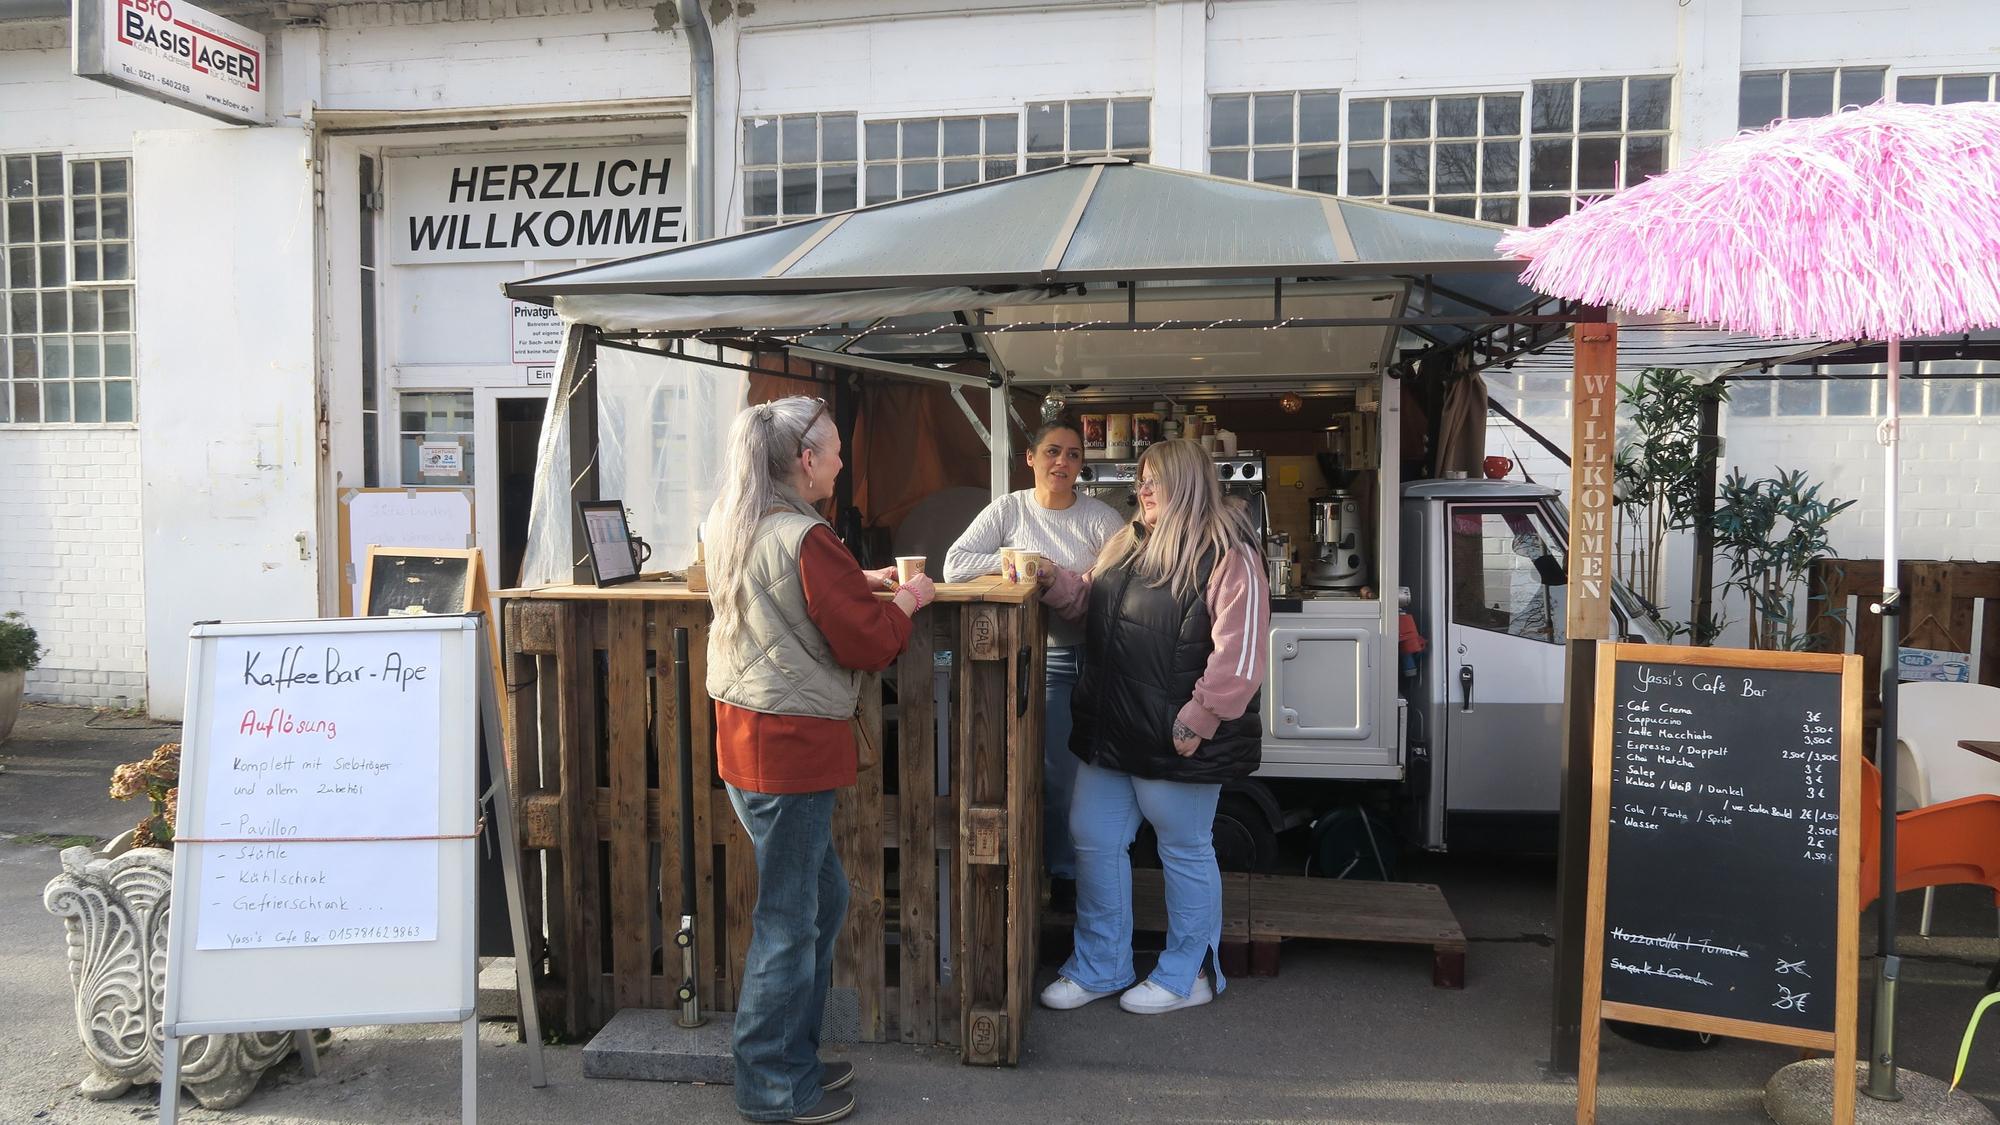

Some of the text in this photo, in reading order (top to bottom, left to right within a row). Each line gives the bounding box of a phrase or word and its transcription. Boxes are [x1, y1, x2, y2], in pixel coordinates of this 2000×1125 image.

[126, 10, 254, 82] BASISLAGER
[138, 70, 155, 82] 0221
[449, 158, 671, 203] HERZLICH
[409, 206, 687, 251] WILLKOMME
[514, 306, 558, 319] Privatgru
[536, 370, 554, 379] Ein
[1580, 375, 1610, 599] WILLKOMMEN
[382, 652, 427, 692] Ape
[1633, 666, 1683, 692] Yassi's
[1740, 678, 1767, 697] Bar
[1627, 714, 1682, 726] Cappuccino
[1660, 703, 1692, 714] Crema
[1806, 711, 1822, 722] 3€
[240, 708, 336, 740] Auflösung
[1628, 727, 1652, 736] Latte
[1658, 730, 1712, 740] Macchiato
[1627, 740, 1670, 752] Espresso
[1687, 746, 1728, 759] Doppelt
[233, 755, 392, 779] Komplett mit Siebträger
[1627, 754, 1648, 762] Chai
[1658, 755, 1695, 768] Matcha
[1627, 765, 1656, 778] Salep
[234, 783, 256, 796] und
[266, 784, 298, 796] allem
[1626, 776, 1656, 788] Kakao
[1708, 785, 1744, 796] Dunkel
[1624, 804, 1646, 815] Cola
[1660, 807, 1688, 820] Fanta
[1706, 814, 1732, 826] Sprite
[1624, 816, 1660, 830] Wasser
[239, 814, 298, 836] Pavillon
[235, 844, 288, 860] Stühle
[233, 894, 350, 912] Gefrierschrank
[304, 930, 320, 943] Bar
